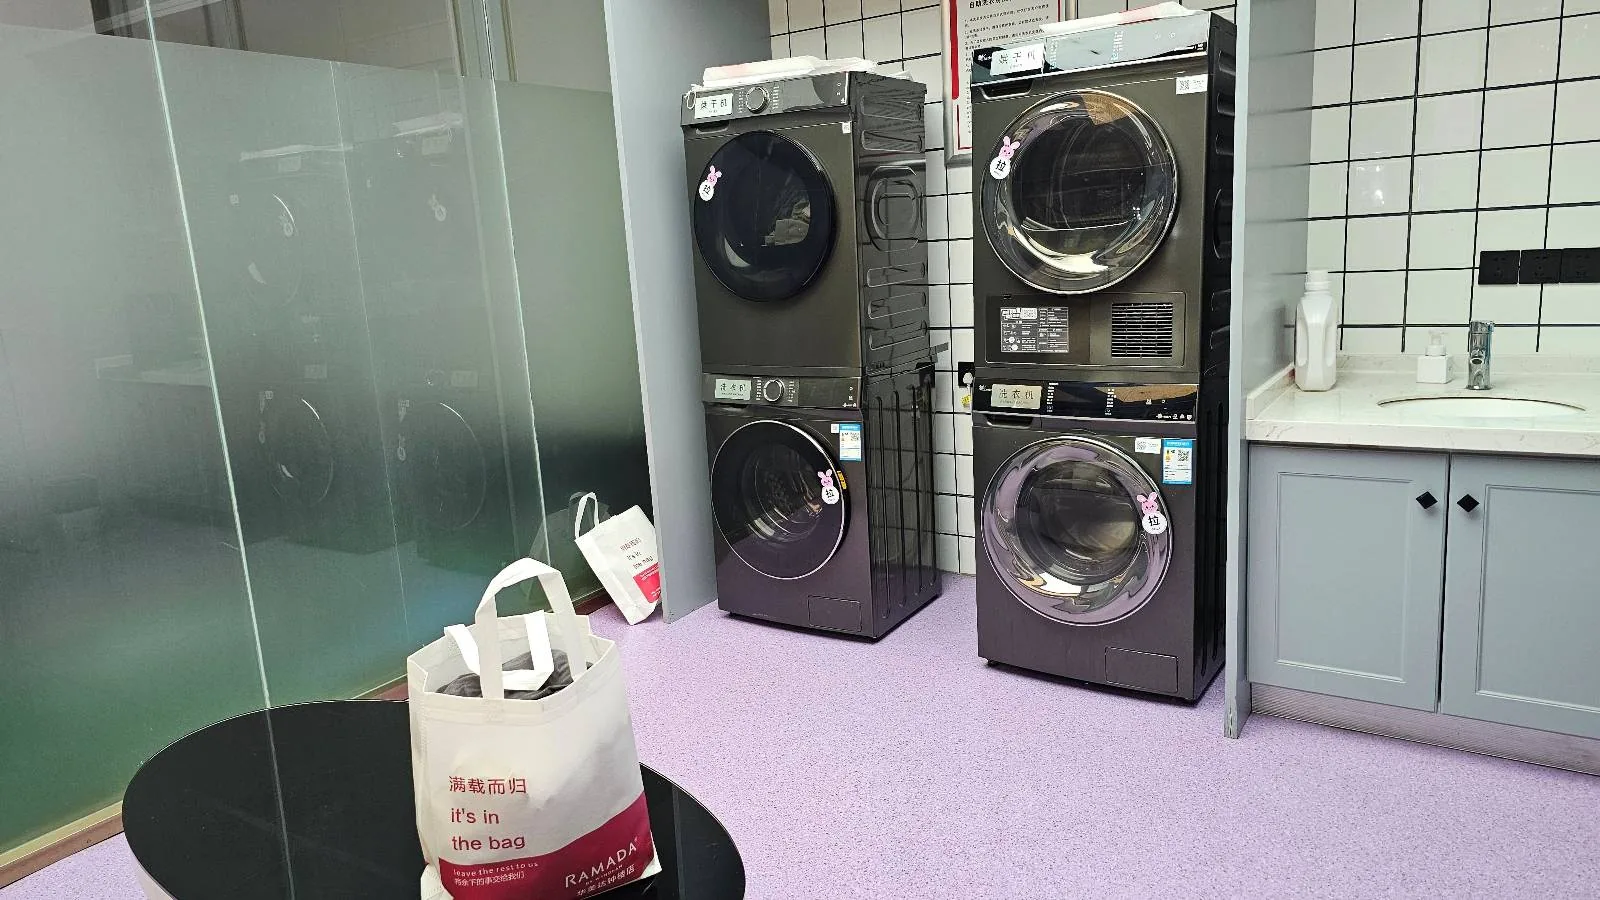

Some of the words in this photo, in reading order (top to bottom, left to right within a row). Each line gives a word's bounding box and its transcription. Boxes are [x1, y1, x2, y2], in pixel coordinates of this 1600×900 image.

[999, 388, 1034, 400] 洗衣机
[1148, 515, 1161, 526] 拉
[449, 776, 527, 795] 满载而归
[451, 808, 477, 824] it's
[483, 809, 500, 824] in
[452, 836, 482, 850] the
[488, 836, 526, 850] bag
[453, 868, 477, 877] leave
[479, 867, 494, 876] the
[496, 863, 514, 873] rest
[565, 842, 637, 888] RAMADA
